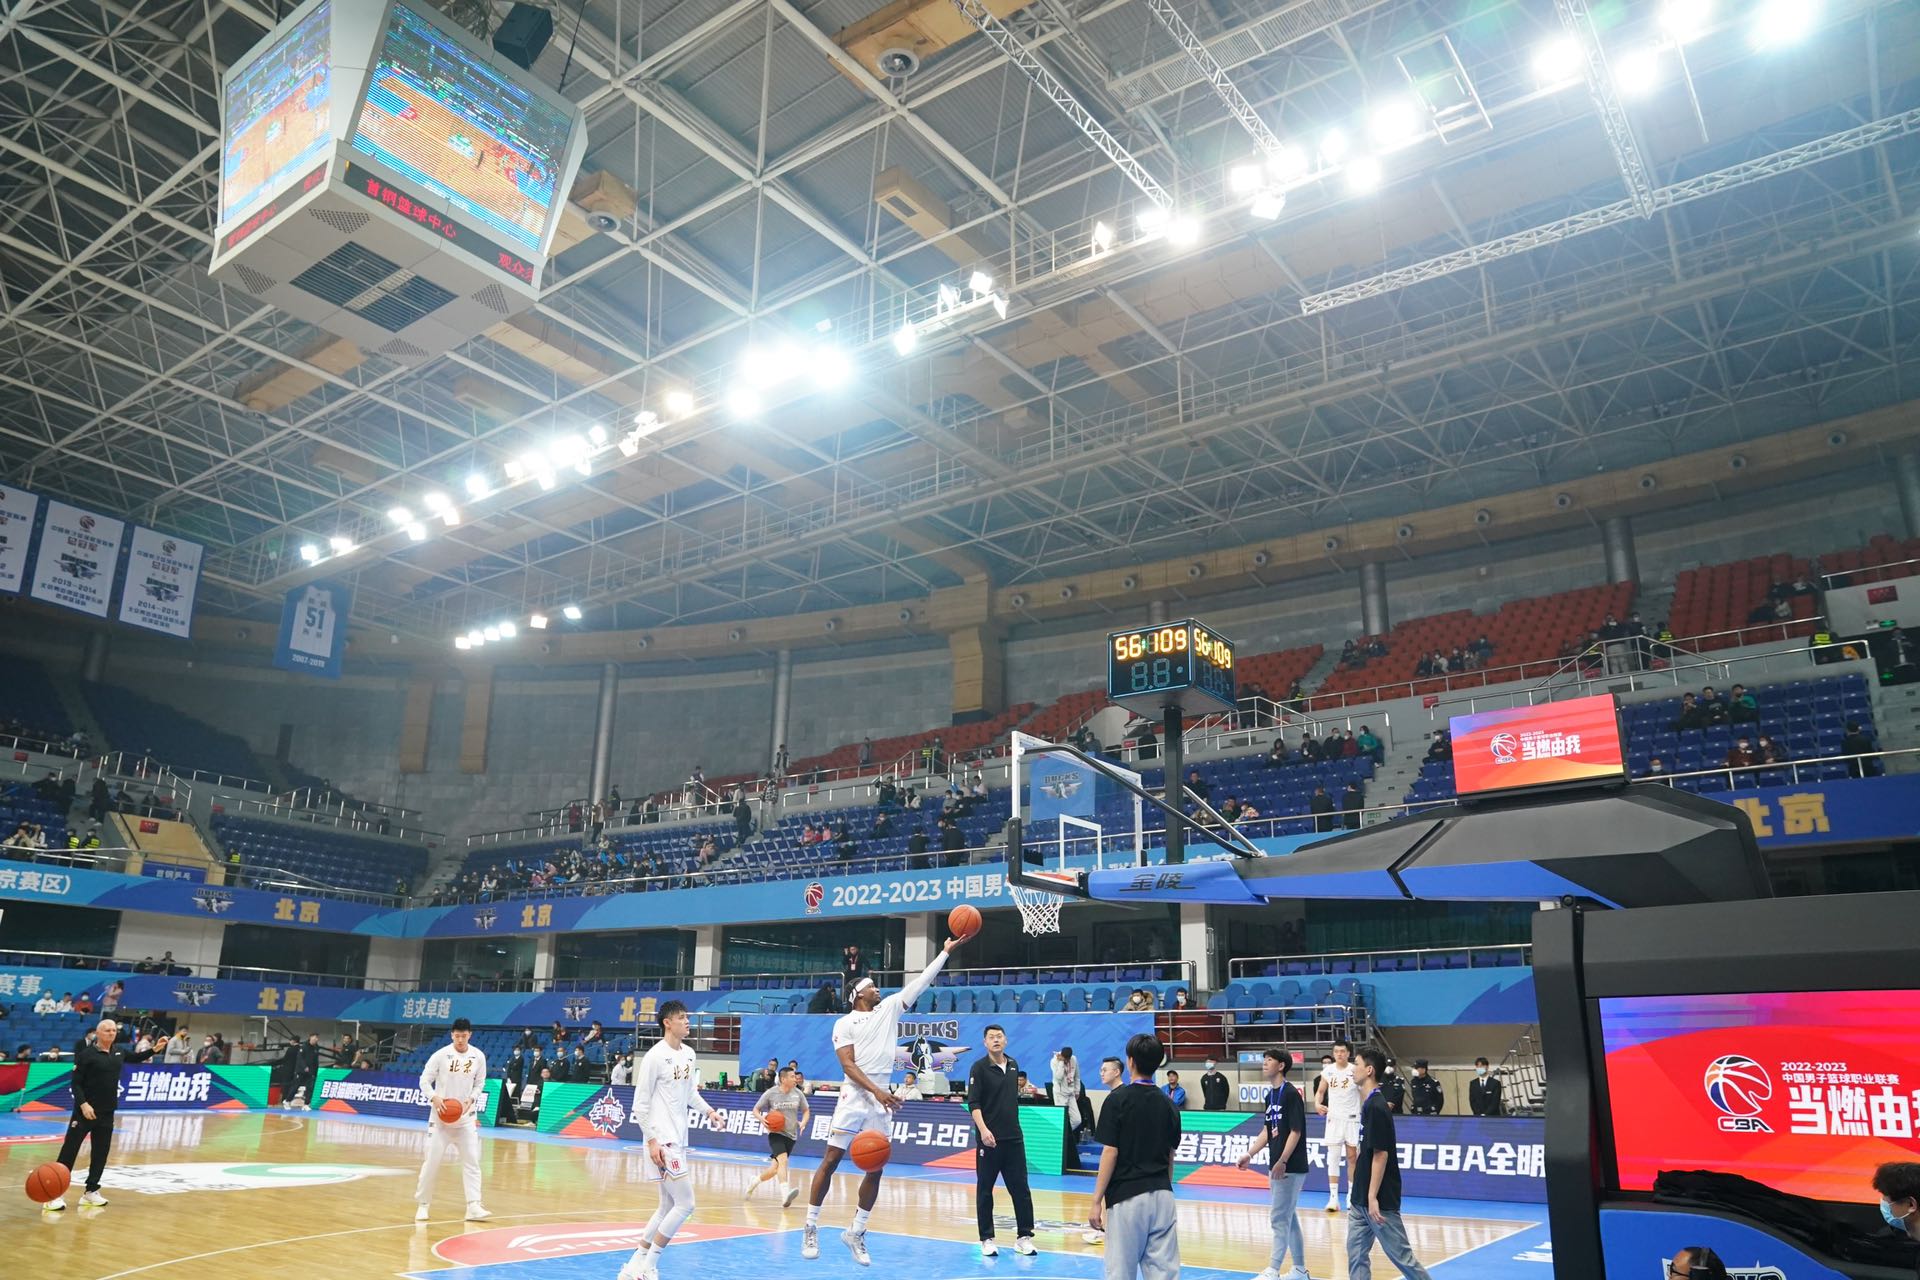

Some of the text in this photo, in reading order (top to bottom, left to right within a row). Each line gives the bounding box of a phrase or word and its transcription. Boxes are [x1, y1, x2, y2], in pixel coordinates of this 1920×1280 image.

[367, 178, 457, 238] 首钢篮球中心
[305, 606, 326, 631] 51
[1521, 734, 1581, 761] 当燃由我
[832, 873, 1013, 907] 2022-2023 中国男
[274, 898, 322, 924] 北京
[520, 903, 553, 928] 北京
[257, 987, 305, 1013] 北京
[402, 997, 451, 1020] 追求卓越
[619, 996, 657, 1022] 北京
[449, 1060, 473, 1074] 北京
[1781, 1062, 1848, 1072] 2022-2023
[1782, 1073, 1900, 1085] 中国男子篮球职业联赛
[125, 1071, 212, 1102] 当燃由我
[888, 1121, 970, 1148] 4-3.26
[1718, 1116, 1775, 1134] CBA
